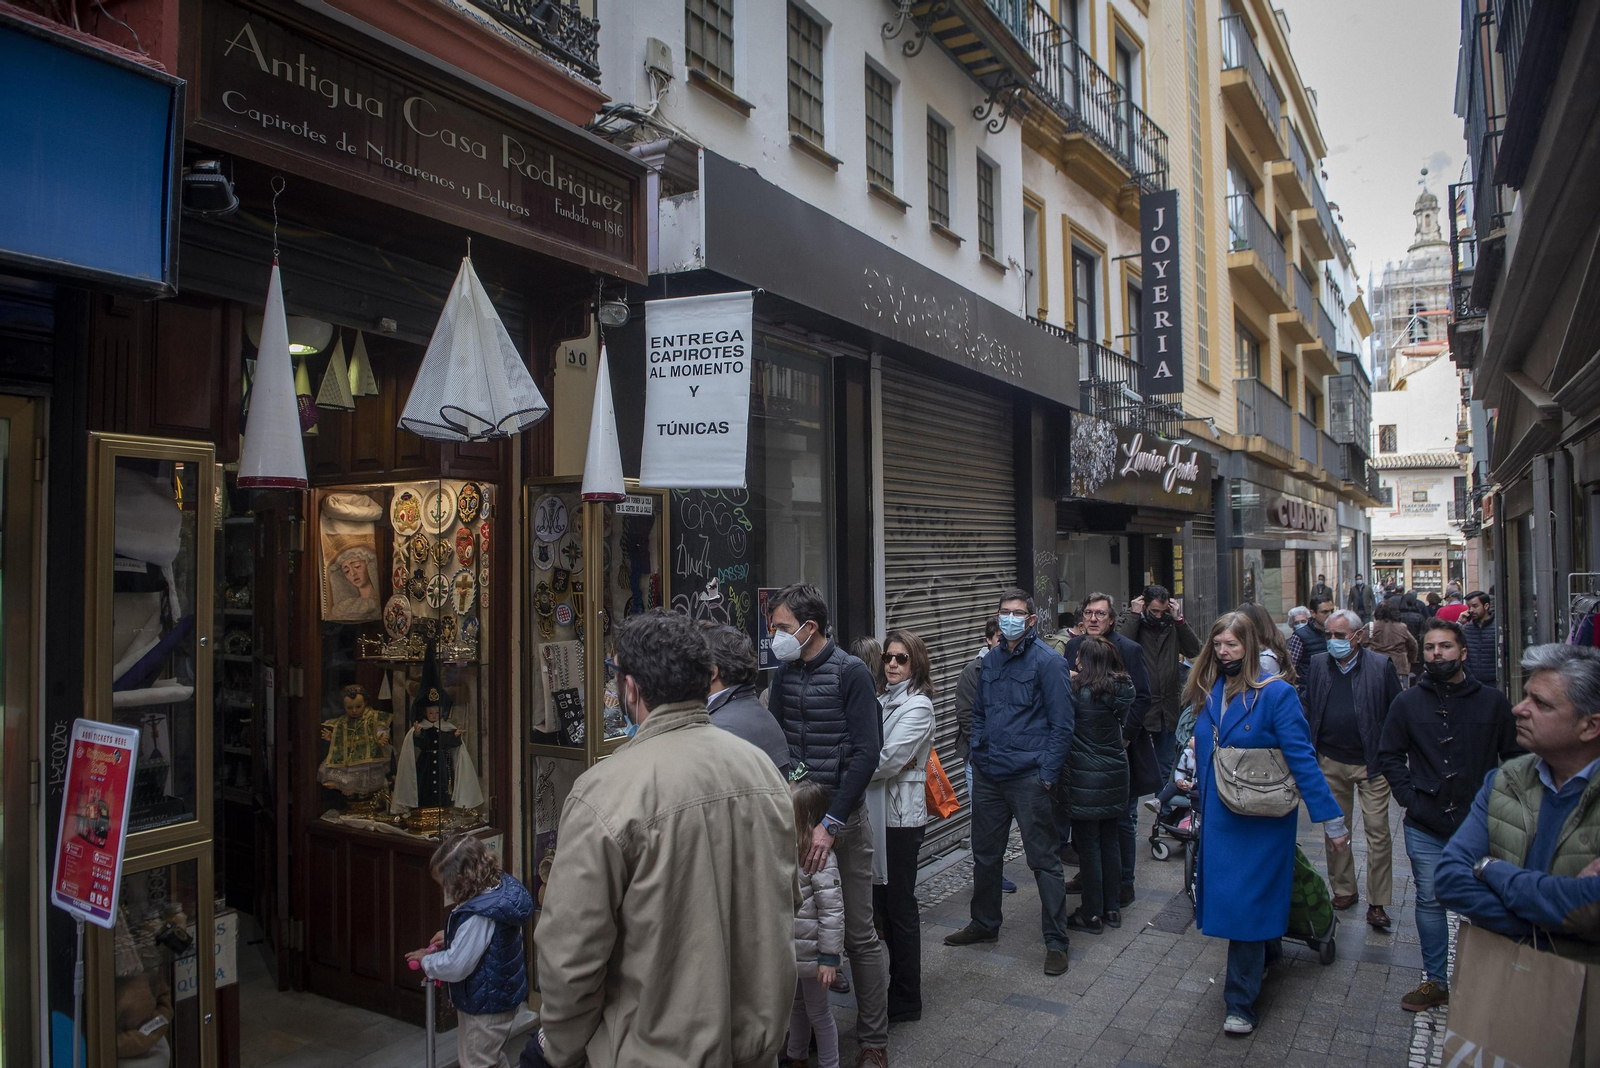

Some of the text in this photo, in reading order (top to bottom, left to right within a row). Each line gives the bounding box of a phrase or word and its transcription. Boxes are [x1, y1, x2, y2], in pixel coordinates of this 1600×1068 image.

[224, 22, 623, 215] Antigua Casa Rodriguez
[222, 90, 530, 217] Capirotes de Nazarenos y Pelucas
[555, 197, 624, 238] Fundada en 1816
[1150, 206, 1173, 380] JOYERIA
[651, 329, 744, 349] ENTREGA
[650, 344, 745, 364] CAPIROTES
[650, 361, 744, 379] AL MOMENTO
[689, 385, 699, 397] Y
[657, 420, 729, 436] TÚNICAS
